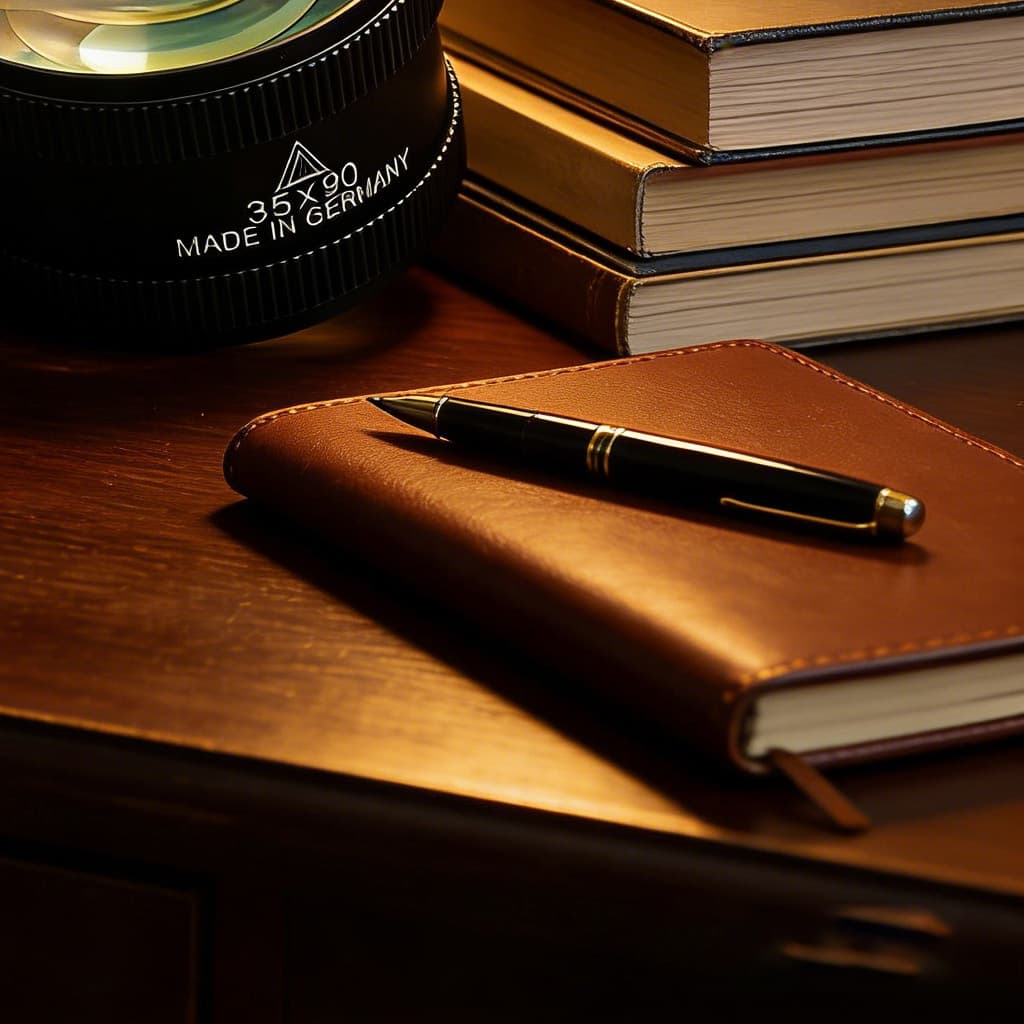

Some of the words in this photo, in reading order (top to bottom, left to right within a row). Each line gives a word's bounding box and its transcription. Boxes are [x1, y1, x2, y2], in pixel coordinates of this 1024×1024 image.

[176, 225, 260, 257] MADE
[271, 215, 296, 240] IN
[306, 146, 409, 226] GERMANY
